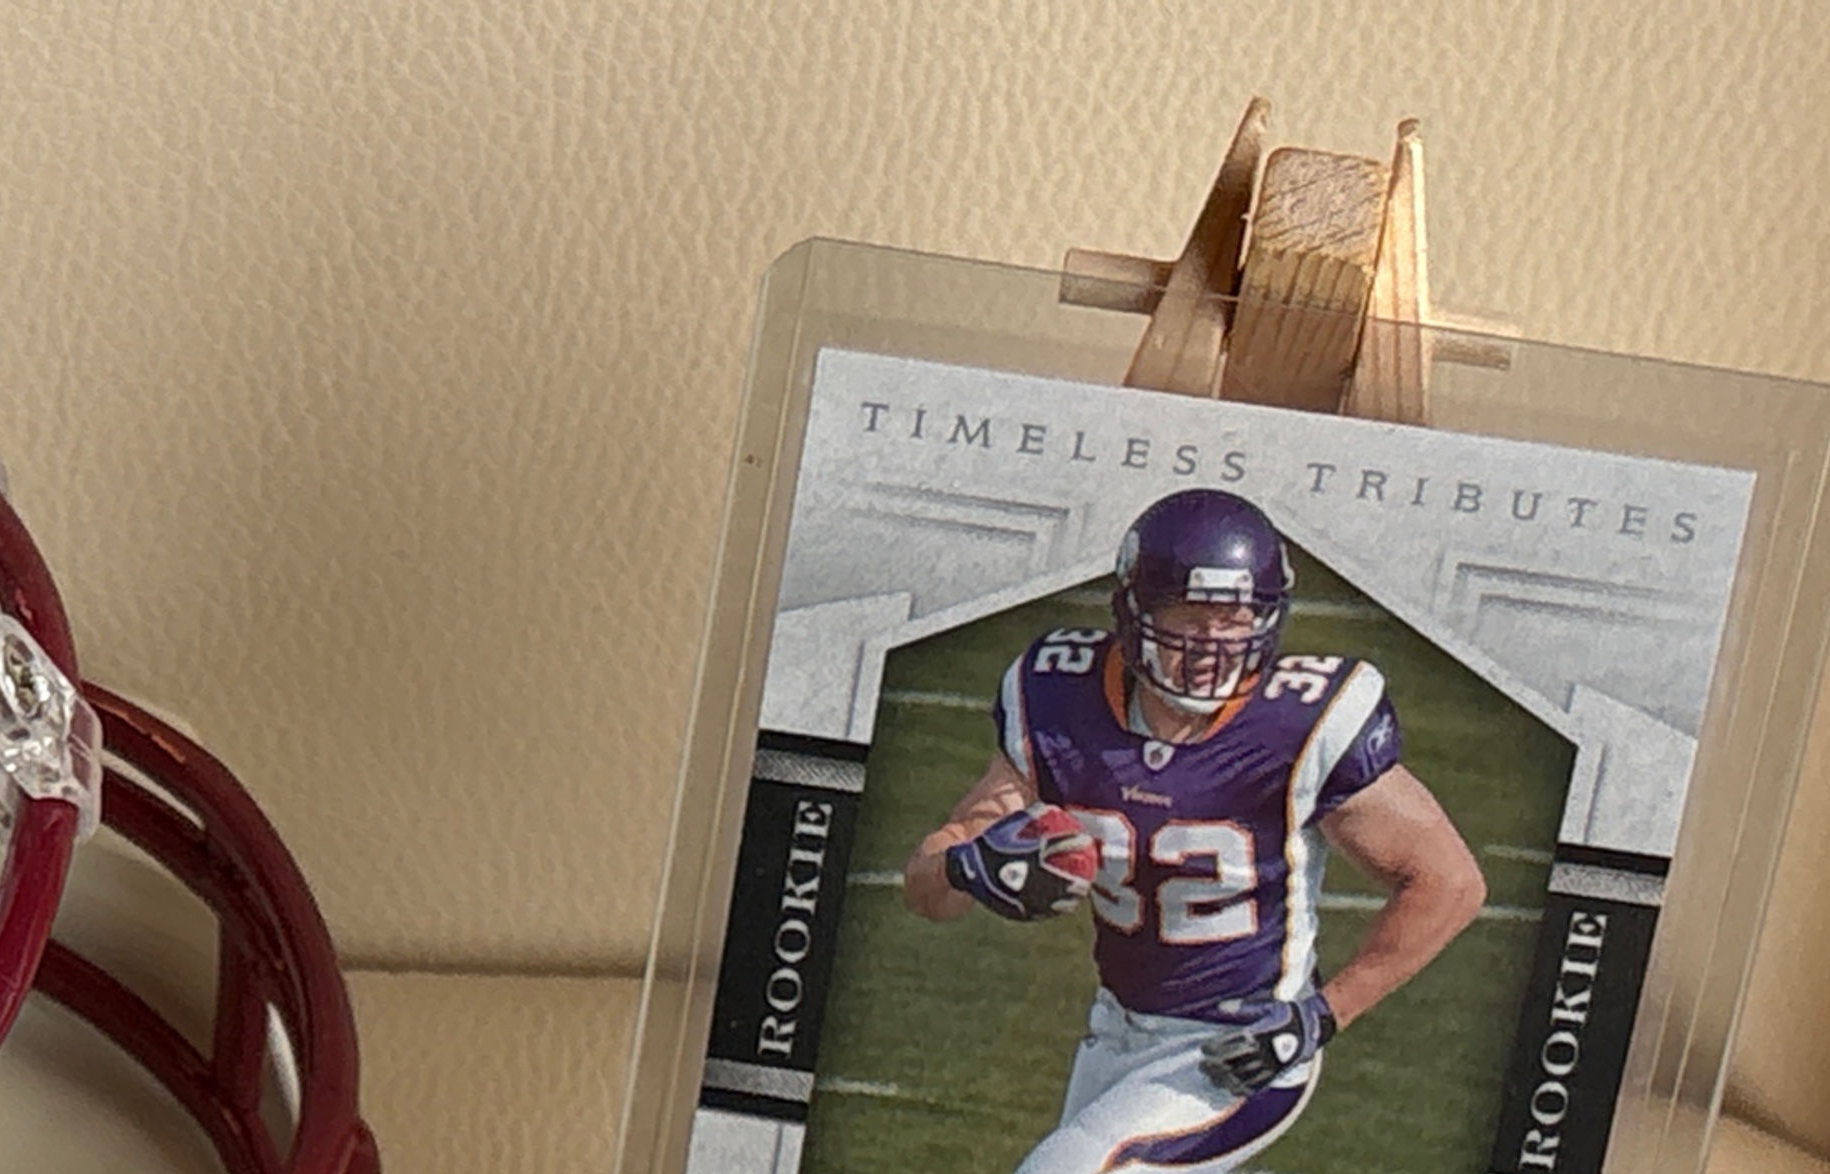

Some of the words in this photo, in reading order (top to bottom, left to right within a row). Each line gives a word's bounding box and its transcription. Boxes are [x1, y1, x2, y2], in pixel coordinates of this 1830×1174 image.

[860, 400, 1247, 483] TIMELESS
[1306, 462, 1699, 544] TRIBUTES
[1033, 626, 1108, 675] 32
[1265, 654, 1344, 704] 32
[757, 800, 834, 1059] ROOKIE
[1064, 803, 1260, 945] 32
[1518, 911, 1608, 1172] ROOKIE
